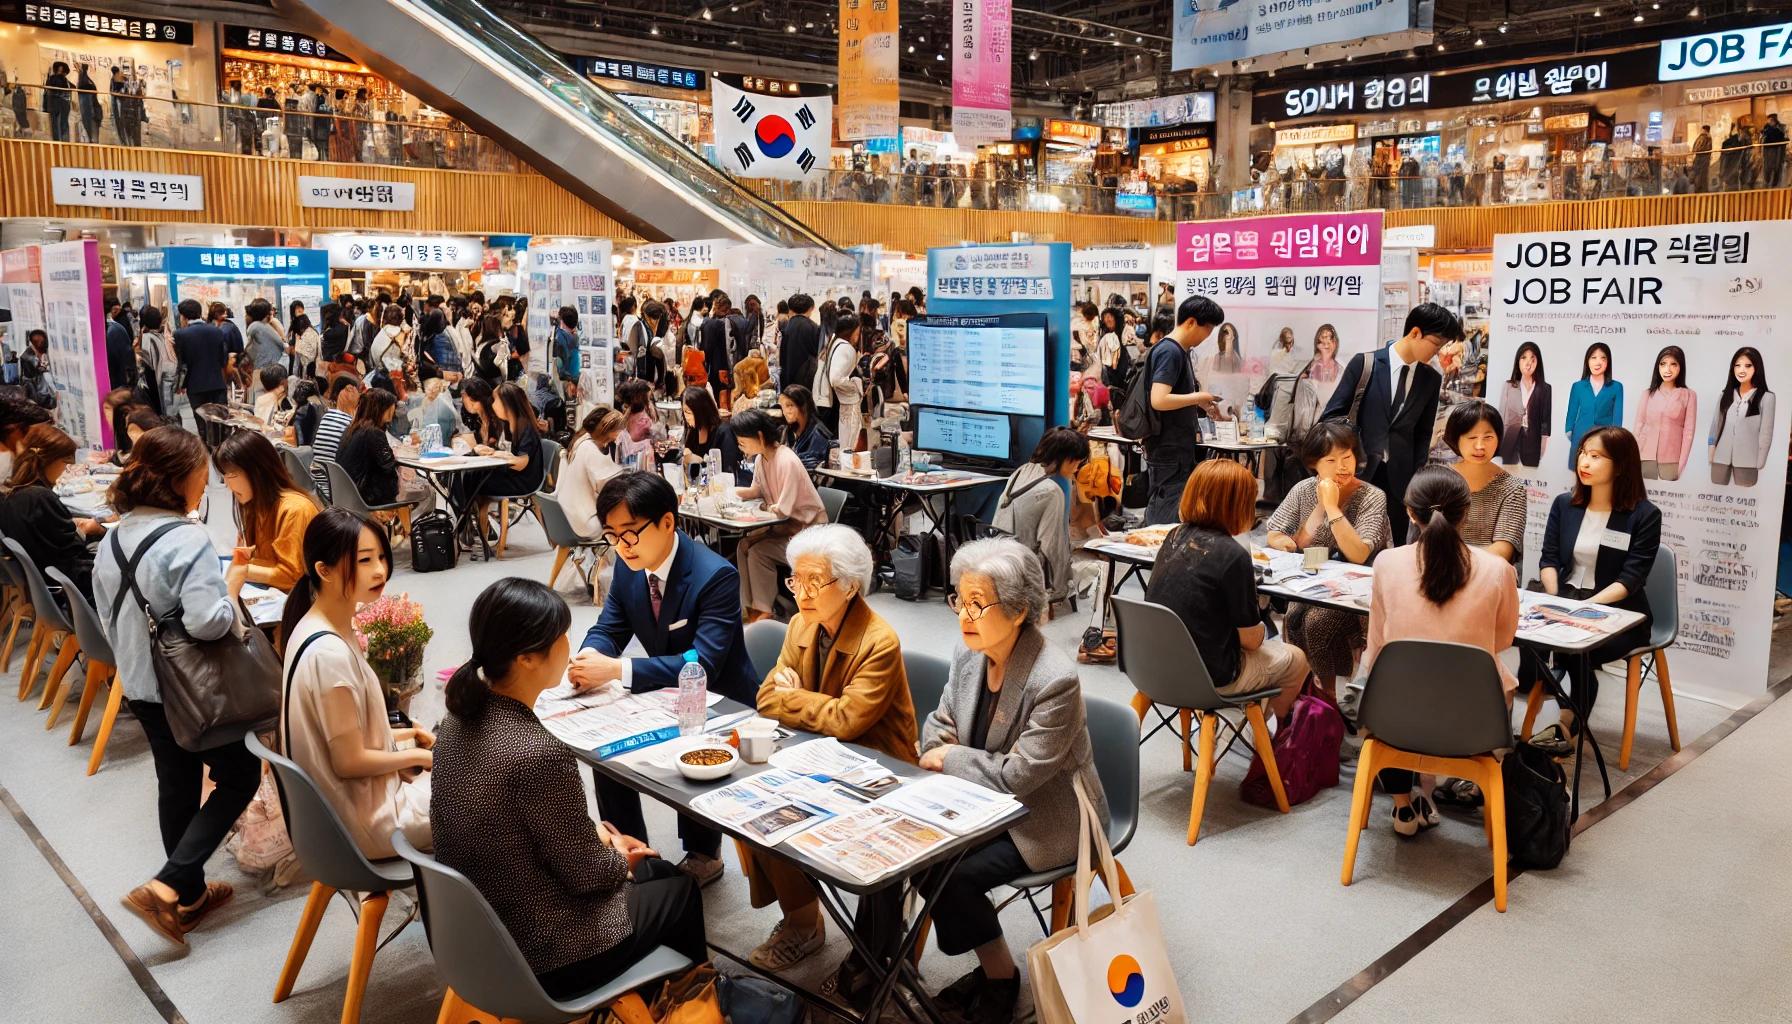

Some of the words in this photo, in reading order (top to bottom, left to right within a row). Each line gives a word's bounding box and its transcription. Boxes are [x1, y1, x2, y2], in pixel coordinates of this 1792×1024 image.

[1667, 33, 1745, 71] JOB
[1506, 241, 1571, 269] JOB
[1581, 238, 1658, 267] FAIR
[1503, 278, 1571, 305] JOB
[1582, 277, 1663, 305] FAIR
